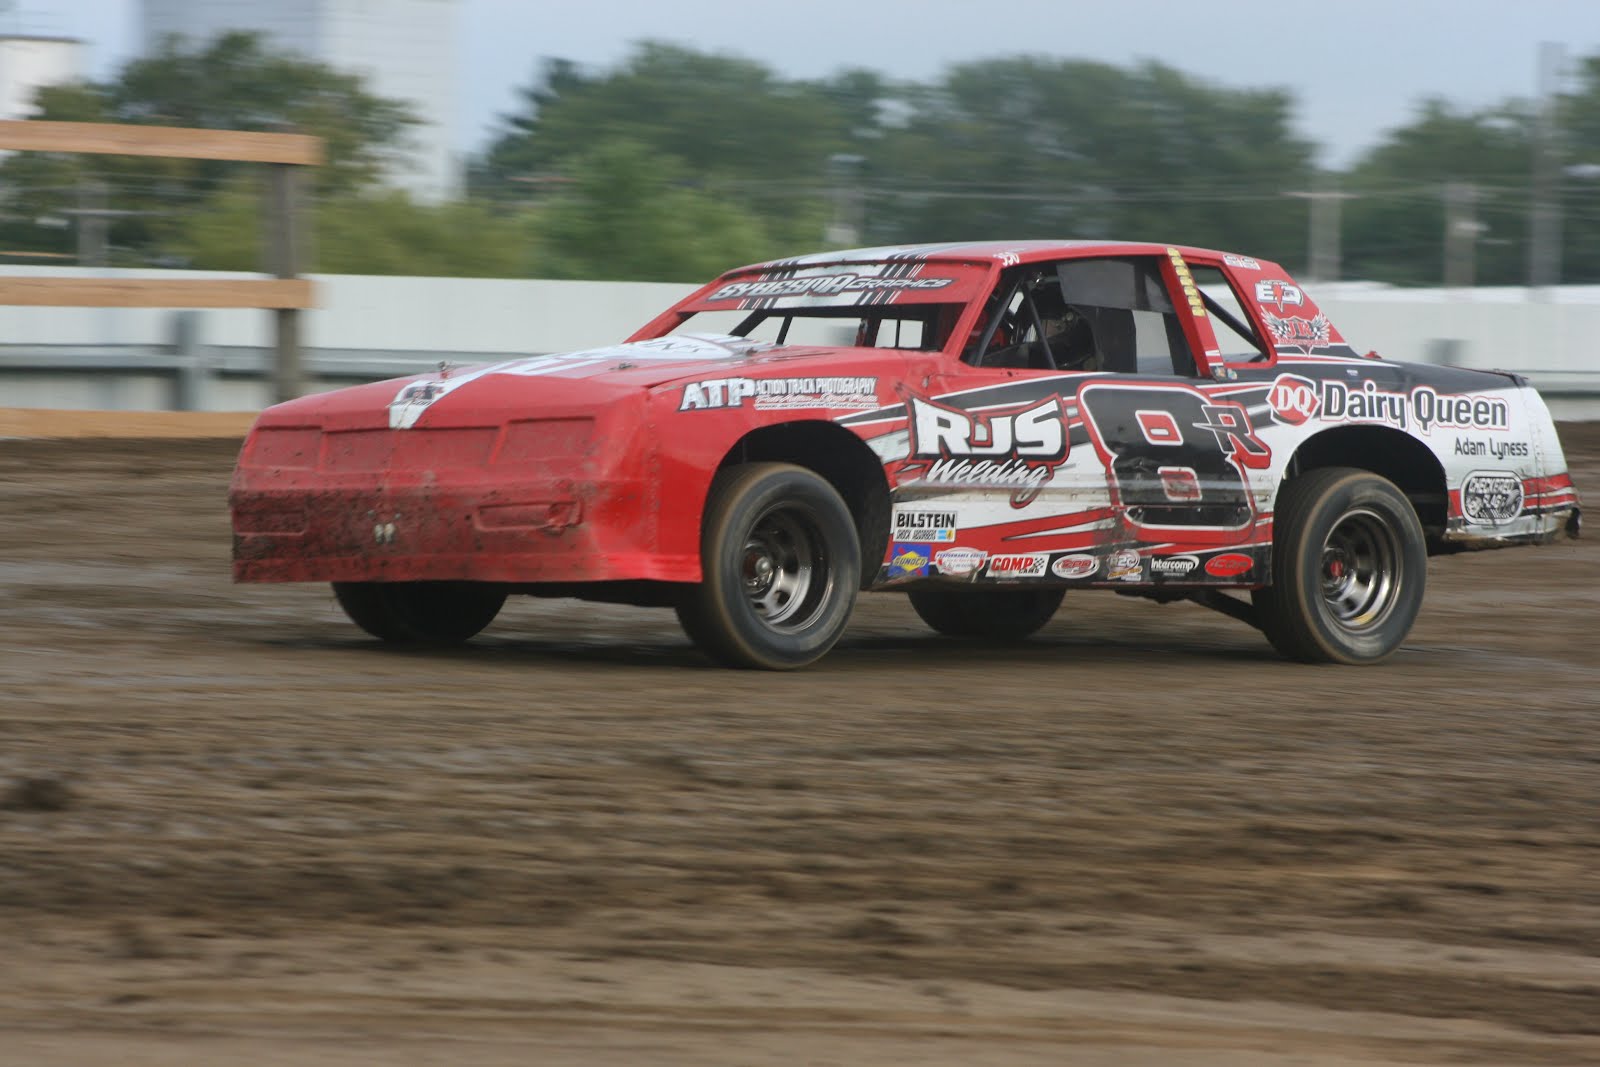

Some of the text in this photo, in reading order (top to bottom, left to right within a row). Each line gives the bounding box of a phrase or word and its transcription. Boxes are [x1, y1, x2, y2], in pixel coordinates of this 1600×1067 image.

[1286, 320, 1314, 338] JR
[680, 378, 755, 411] ATP
[756, 379, 786, 394] ACTION
[786, 378, 816, 394] TRACK
[816, 377, 878, 394] PHOTOGRAPHY
[1276, 385, 1312, 416] DQ
[1323, 383, 1506, 431] Dairy Queen
[912, 398, 1062, 456] RJS
[1455, 437, 1528, 460] Adam Lyness
[926, 458, 1050, 502] Welding
[896, 513, 956, 528] BILSTEIN
[893, 556, 928, 567] SUNOCO
[991, 557, 1034, 571] COMP
[1151, 557, 1194, 573] Intercomp
